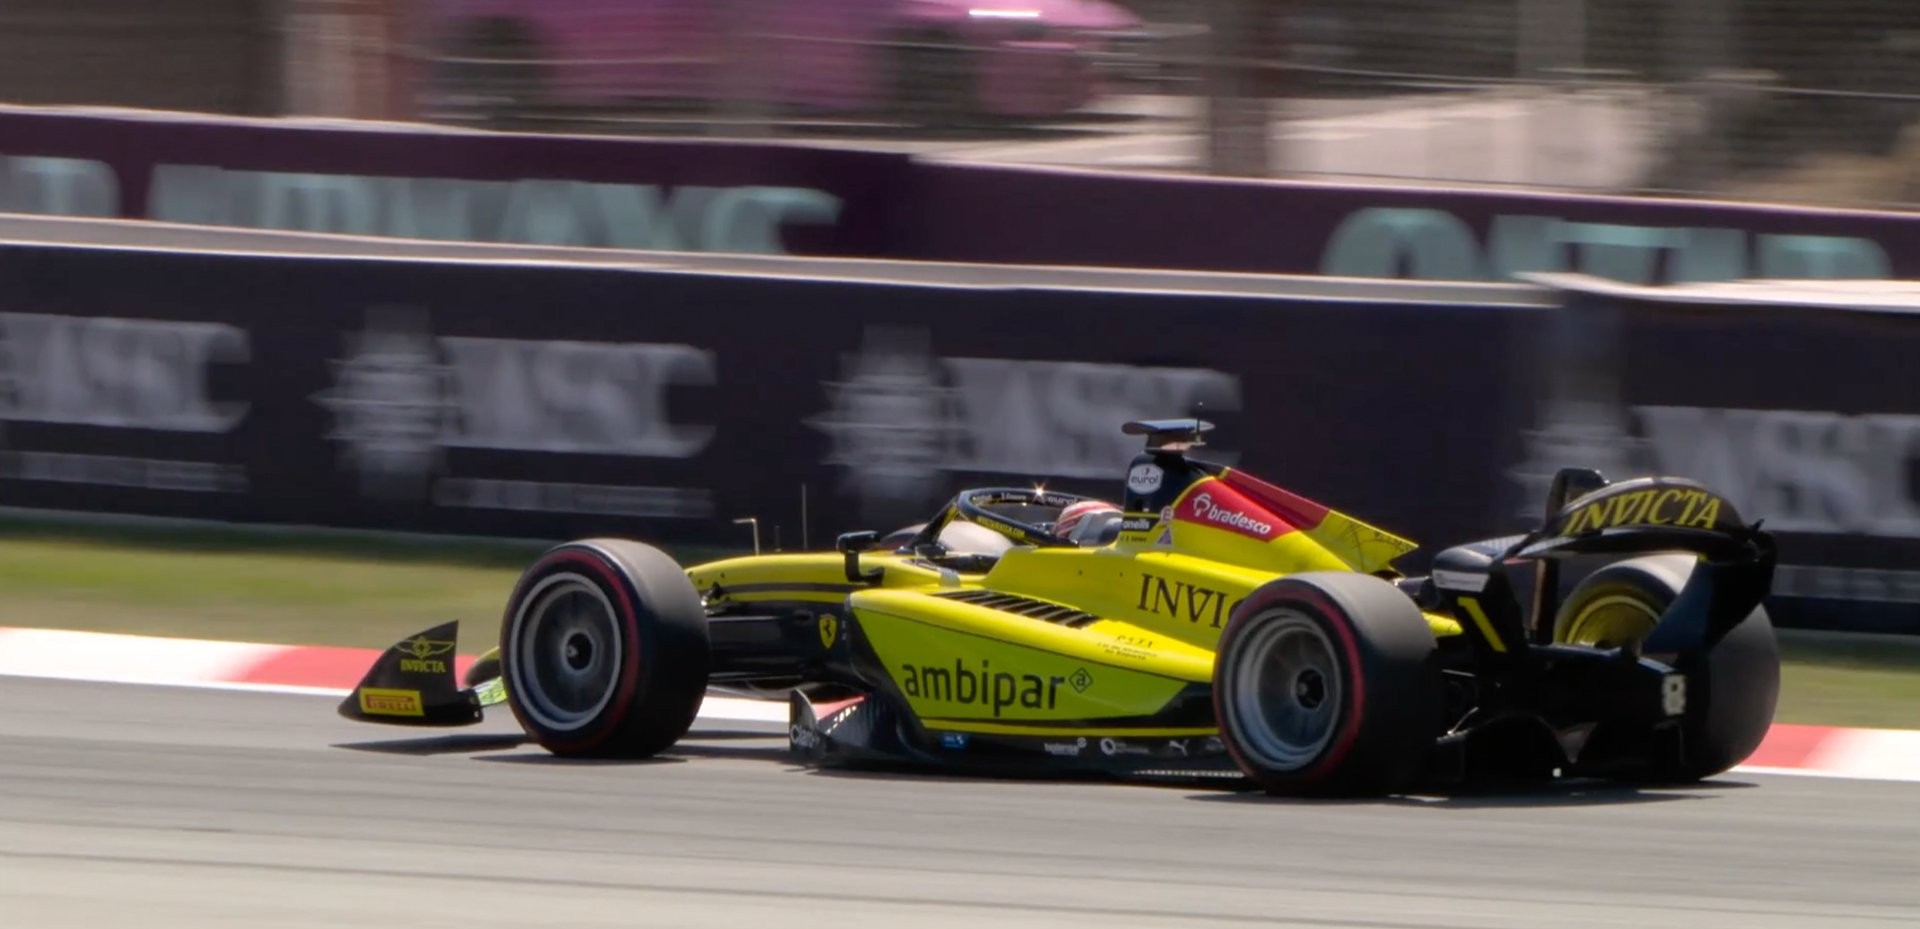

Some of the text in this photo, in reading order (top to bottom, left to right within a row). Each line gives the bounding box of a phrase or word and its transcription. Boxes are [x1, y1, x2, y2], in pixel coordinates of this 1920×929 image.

[1130, 475, 1160, 485] eurol
[1207, 504, 1272, 535] bradesco
[1561, 487, 1723, 537] INVICTA
[1136, 572, 1242, 630] INVI
[400, 659, 447, 673] INVICTA
[902, 657, 1066, 717] ambipar
